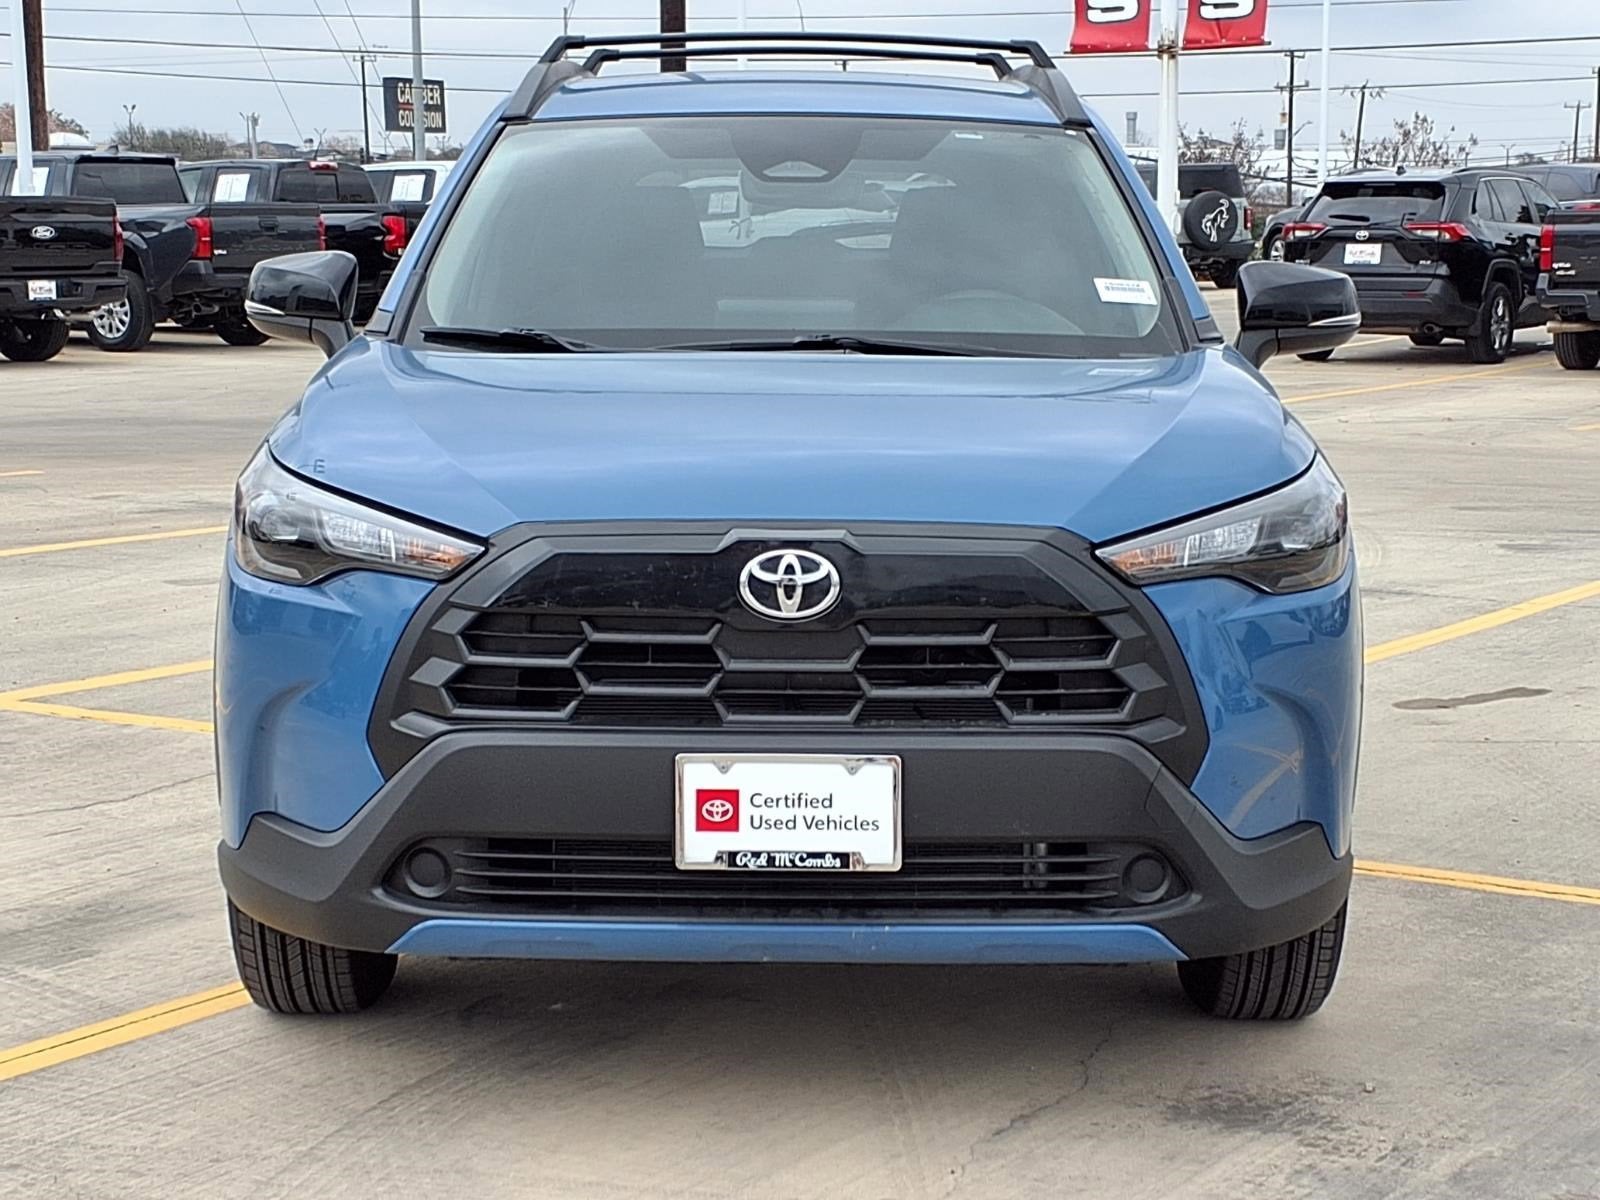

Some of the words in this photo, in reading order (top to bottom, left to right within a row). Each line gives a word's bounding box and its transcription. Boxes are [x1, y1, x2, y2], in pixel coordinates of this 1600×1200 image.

[397, 82, 441, 105] CABER
[399, 109, 442, 128] COLSION
[750, 792, 833, 809] Certified
[750, 815, 797, 830] Used
[803, 815, 880, 831] Vehicles
[736, 851, 769, 869] Red
